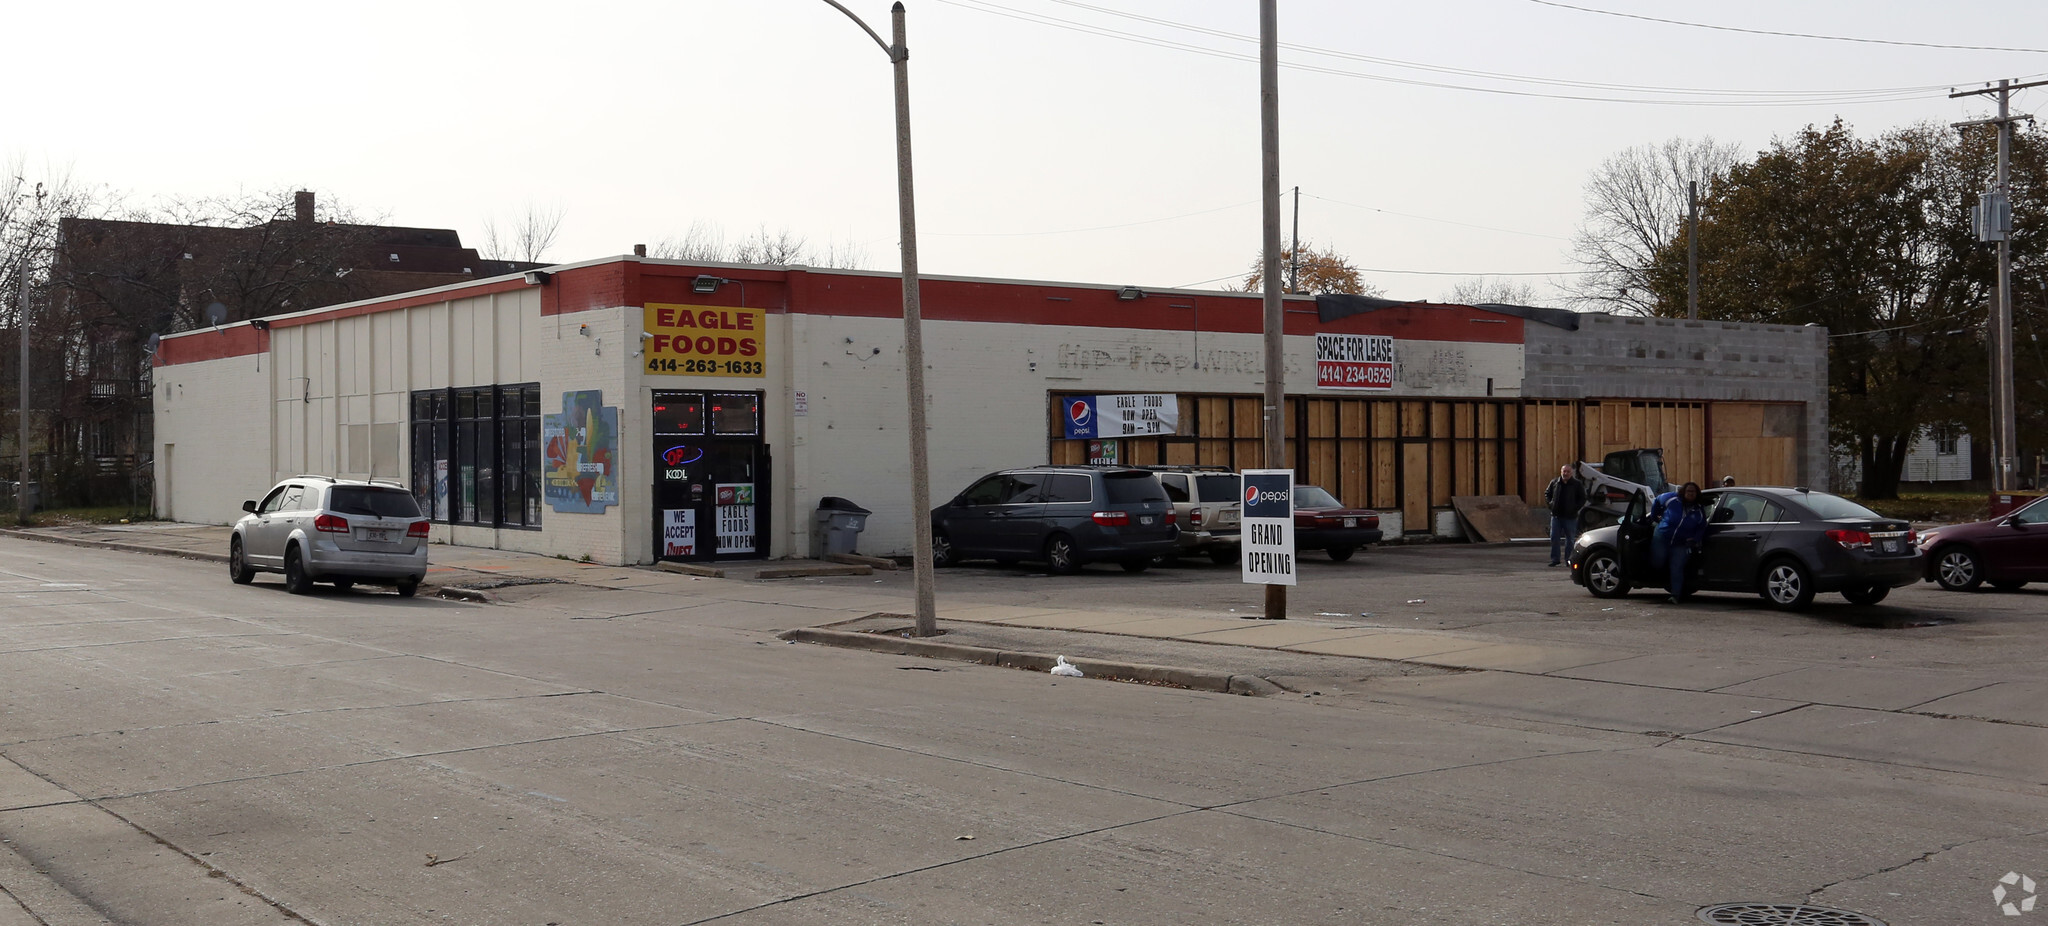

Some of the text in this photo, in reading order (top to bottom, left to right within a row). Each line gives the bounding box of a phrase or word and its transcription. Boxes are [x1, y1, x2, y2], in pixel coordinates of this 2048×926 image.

[657, 308, 754, 331] EAGLE
[653, 334, 758, 357] FOODS
[1317, 336, 1393, 362] SPACE FOR LEASE
[648, 358, 763, 375] 414-263-1633
[1318, 365, 1392, 384] (414) 234-0529
[1116, 395, 1163, 408] EAGLE FOODS
[1122, 409, 1157, 422] NOW OPEN
[1073, 427, 1090, 436] pepsi
[1122, 423, 1135, 435] 9AM
[1147, 421, 1160, 434] 9PM
[665, 469, 688, 480] KOOL
[1260, 489, 1289, 503] pepsi
[673, 510, 686, 523] WE
[722, 505, 749, 519] EAGLE
[664, 525, 694, 539] ACCEPT
[722, 519, 749, 533] FOODS
[1251, 523, 1283, 546] GRAND
[716, 535, 755, 549] NOW OPEN
[1248, 552, 1291, 575] OPENING
